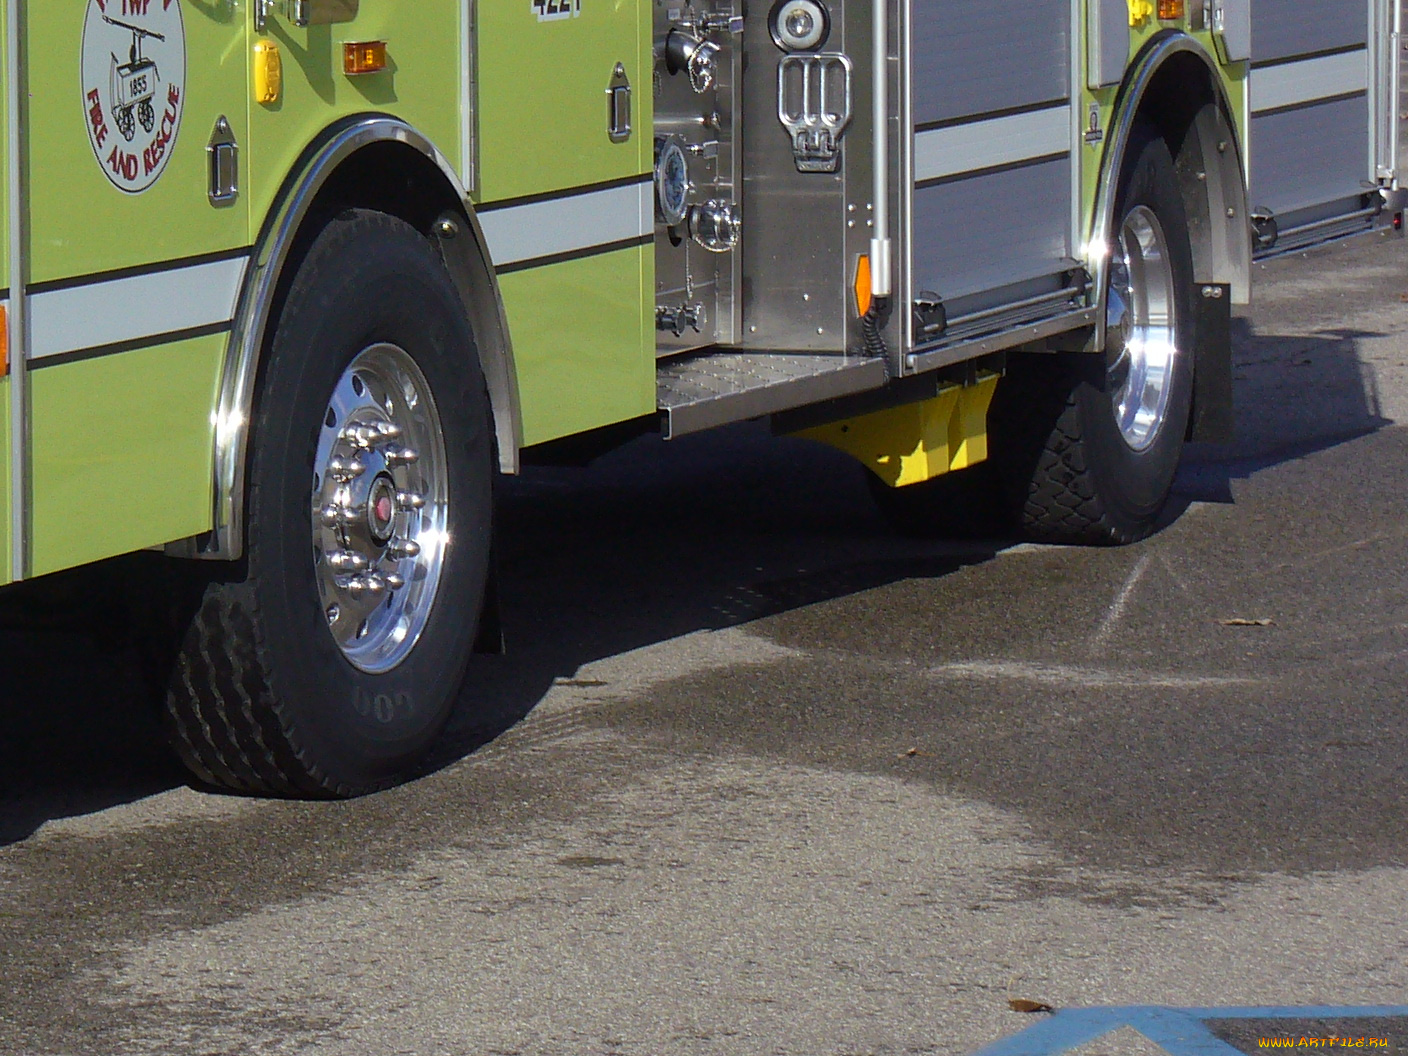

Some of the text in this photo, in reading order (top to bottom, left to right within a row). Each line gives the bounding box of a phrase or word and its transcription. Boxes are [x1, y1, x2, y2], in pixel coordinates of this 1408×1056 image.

[87, 82, 181, 181] FIRE AND RESCUE
